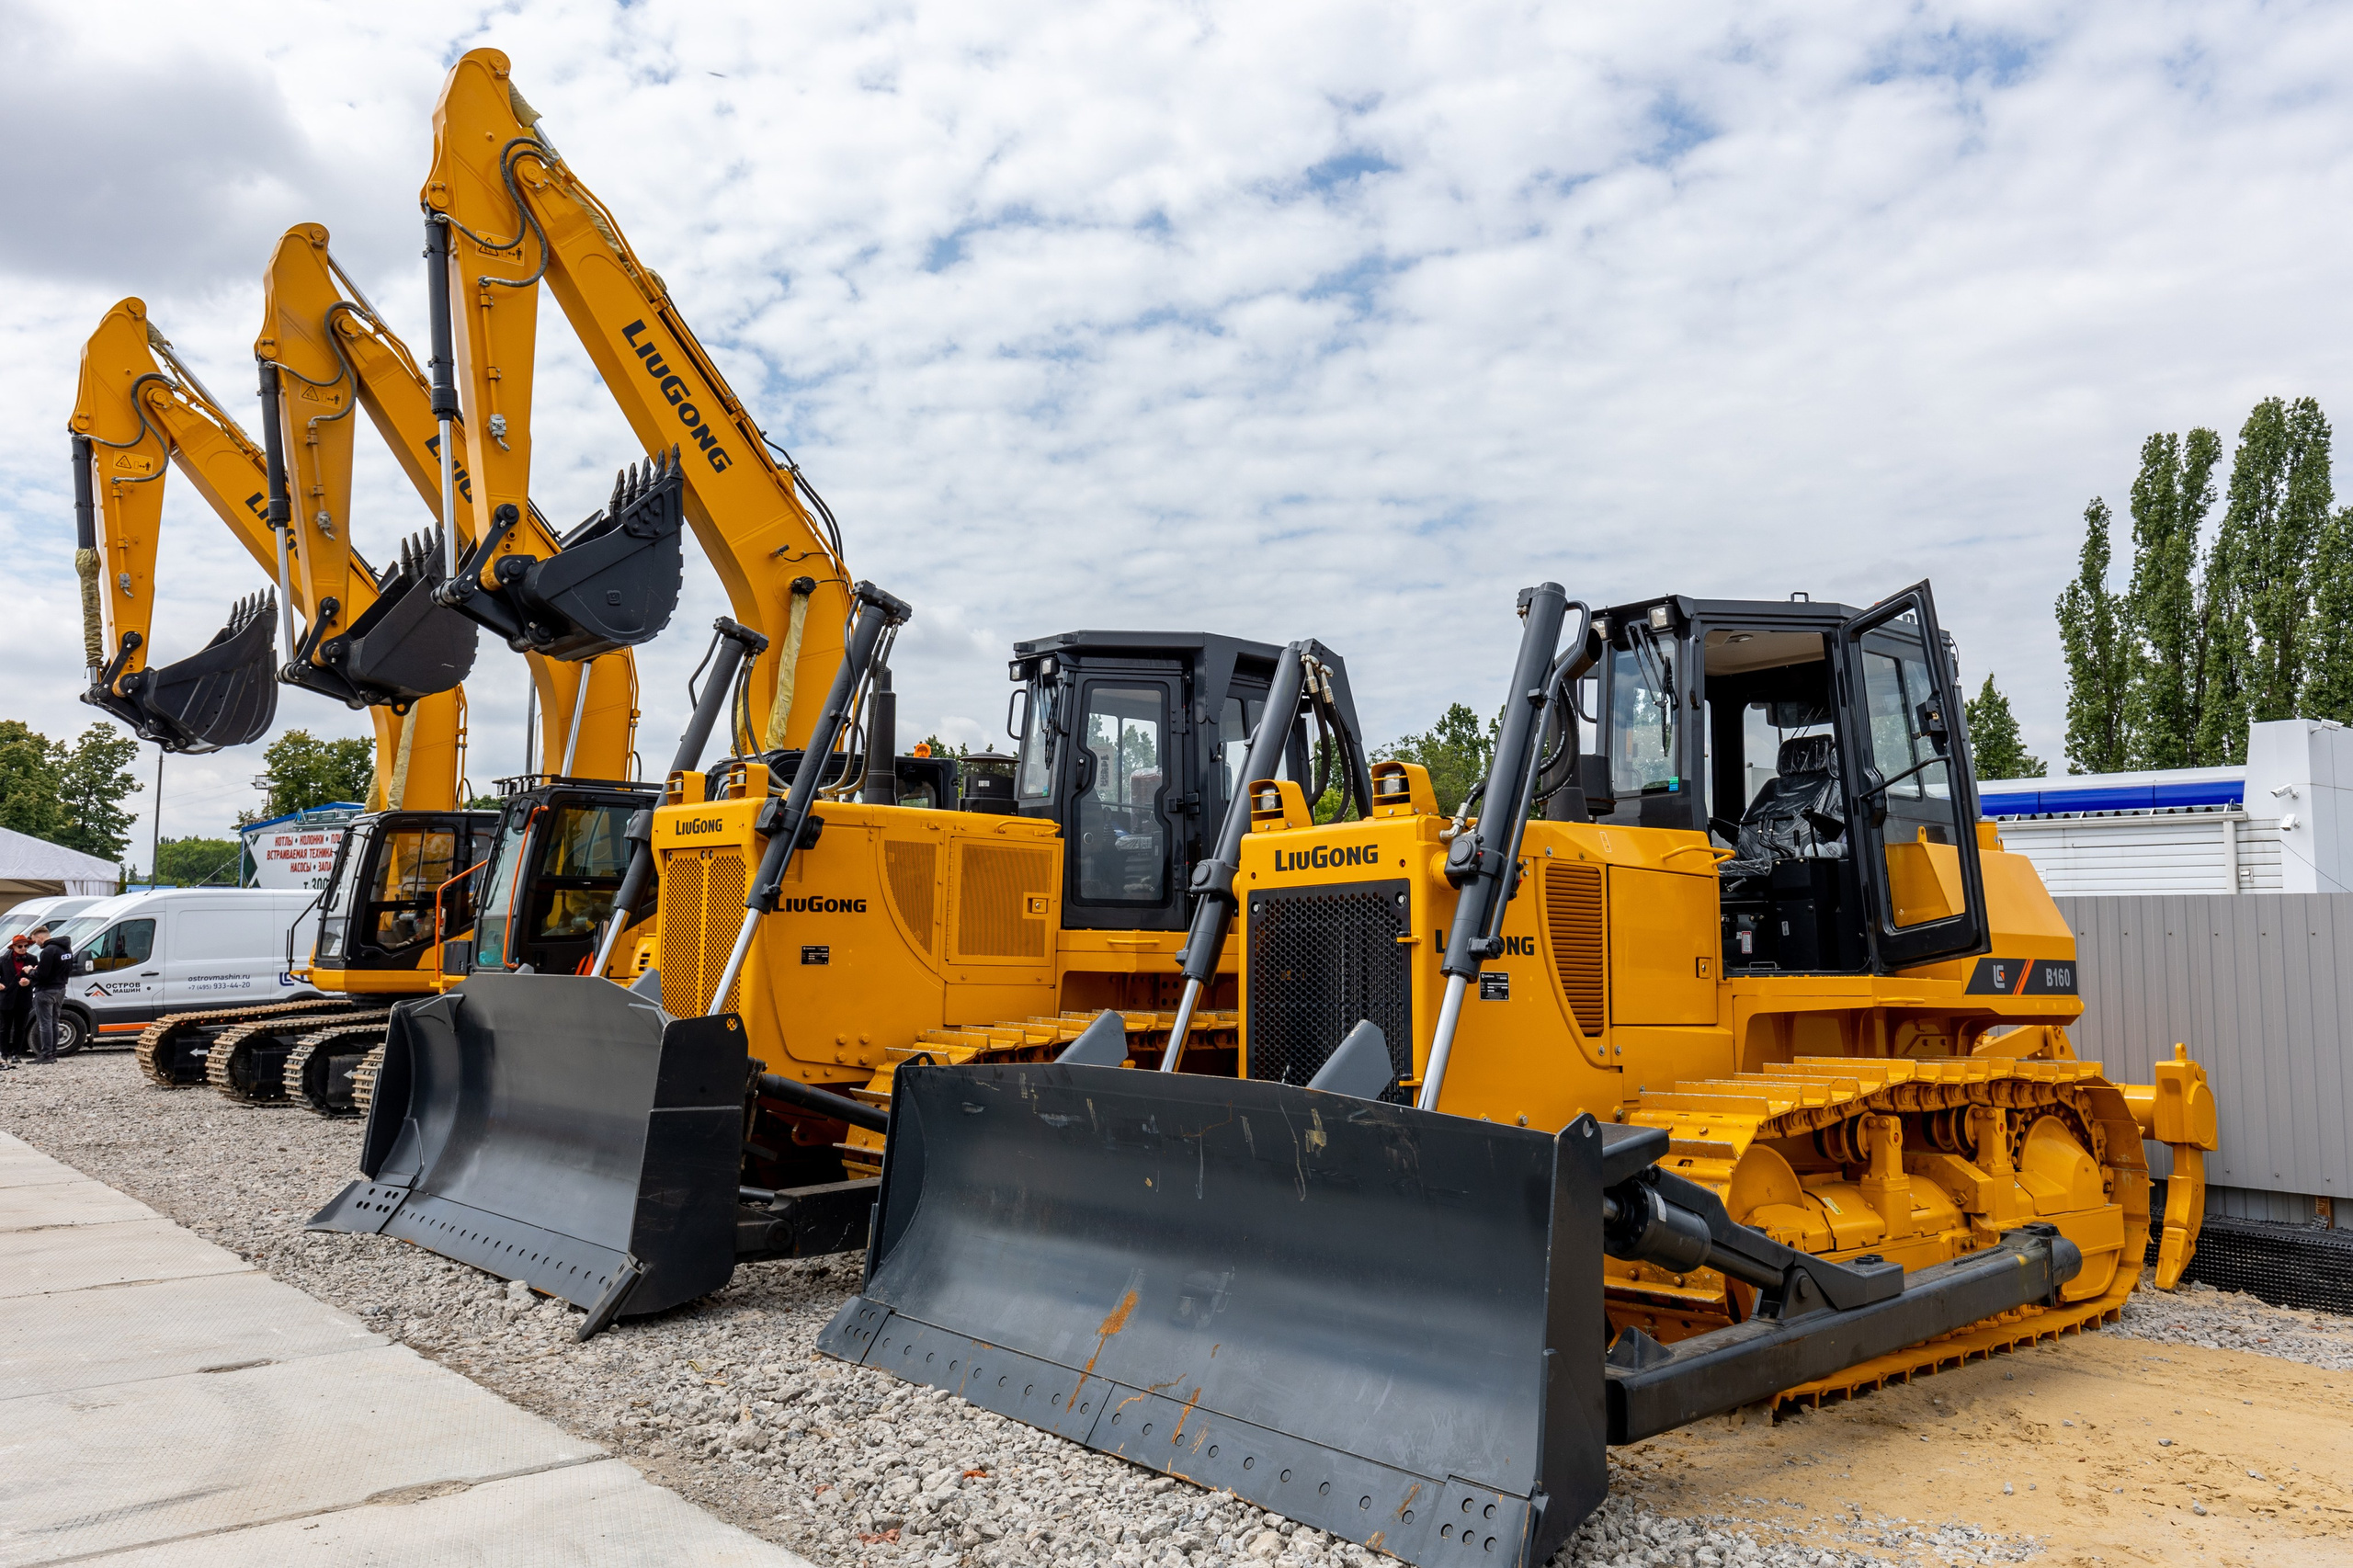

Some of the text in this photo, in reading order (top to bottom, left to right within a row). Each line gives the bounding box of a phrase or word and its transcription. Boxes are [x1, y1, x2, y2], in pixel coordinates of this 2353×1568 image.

[274, 835, 294, 846] КОТЛЫ
[299, 834, 324, 846] КОЛОНКИ
[267, 847, 333, 860] ВСТРАИВАЕМАЯ ТЕХНИКА
[290, 862, 312, 873] НАСОСЫ
[188, 973, 251, 982] ostrovmashin.ru
[2045, 968, 2071, 987] B160
[213, 982, 251, 990] 933-44-20
